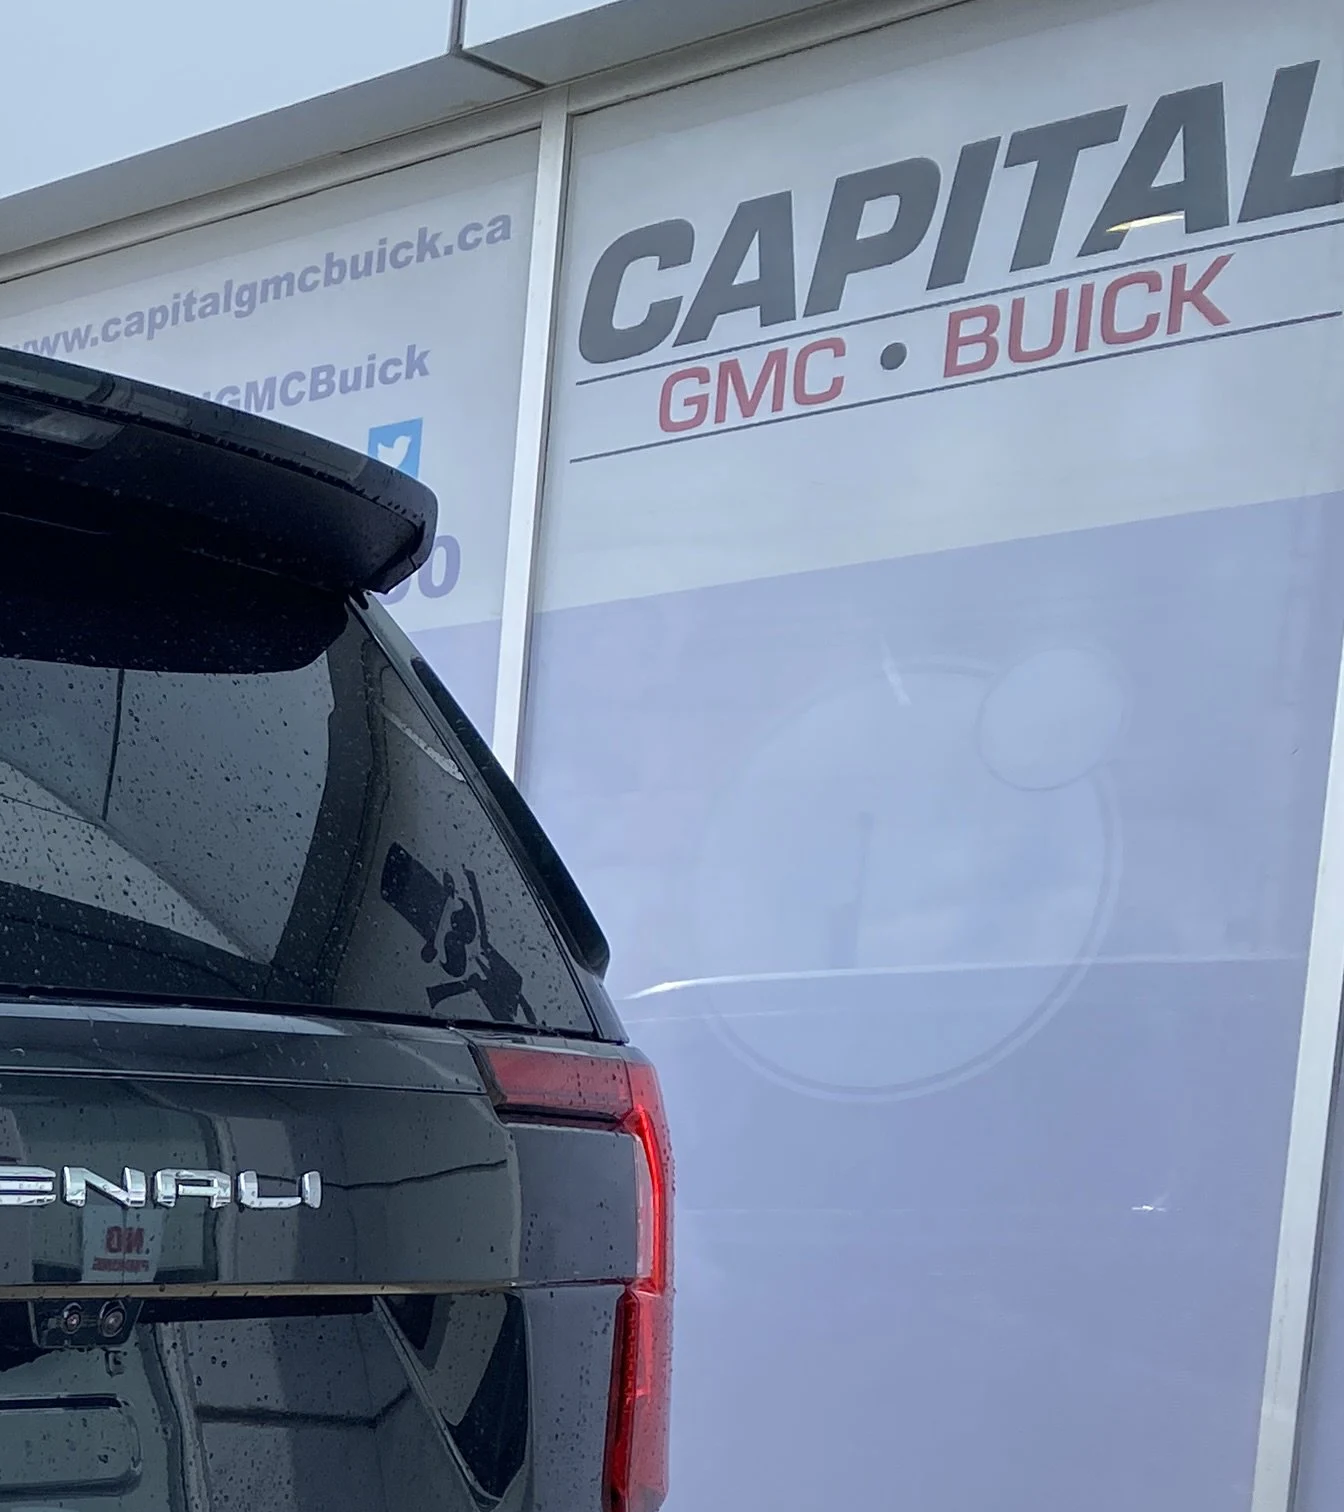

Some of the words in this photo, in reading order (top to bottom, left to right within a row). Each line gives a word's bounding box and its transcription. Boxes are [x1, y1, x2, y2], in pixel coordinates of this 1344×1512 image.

[12, 213, 512, 356] ww.capitalgmcbuick.ca
[578, 59, 1344, 364] CAPITAL
[202, 344, 431, 413] GMCBuick
[658, 337, 846, 433] GMC
[943, 253, 1236, 378] BUICK
